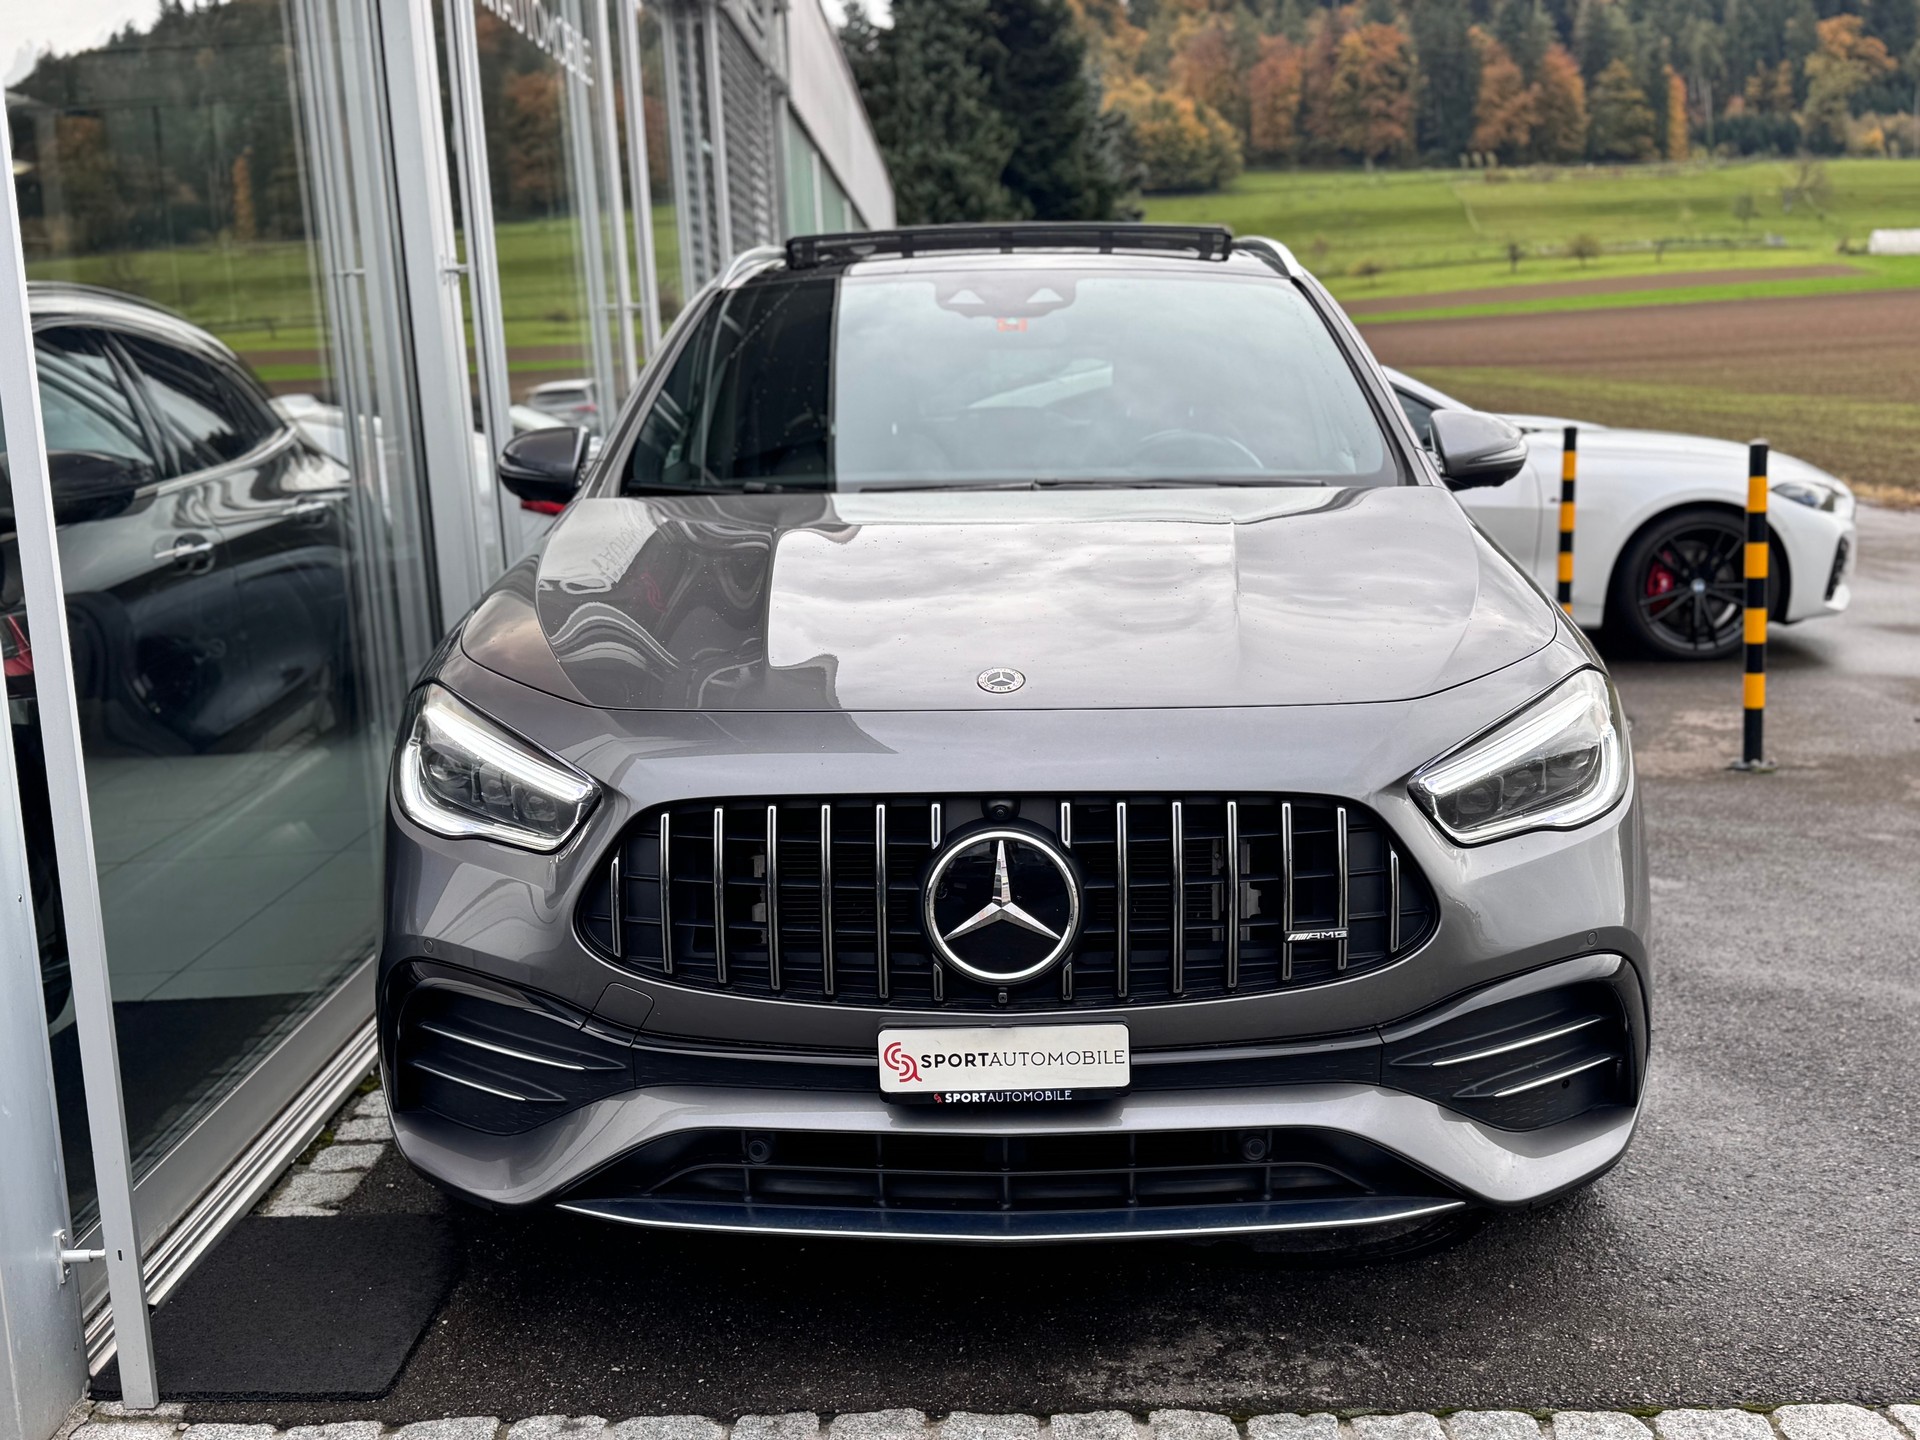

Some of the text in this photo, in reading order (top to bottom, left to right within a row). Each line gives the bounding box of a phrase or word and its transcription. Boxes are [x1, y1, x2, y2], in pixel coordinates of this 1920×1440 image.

[1306, 931, 1348, 940] AMG
[920, 1050, 1126, 1068] SPORTAUTOMOBILE
[944, 1090, 1073, 1104] SPORTAUTOMOBILE
